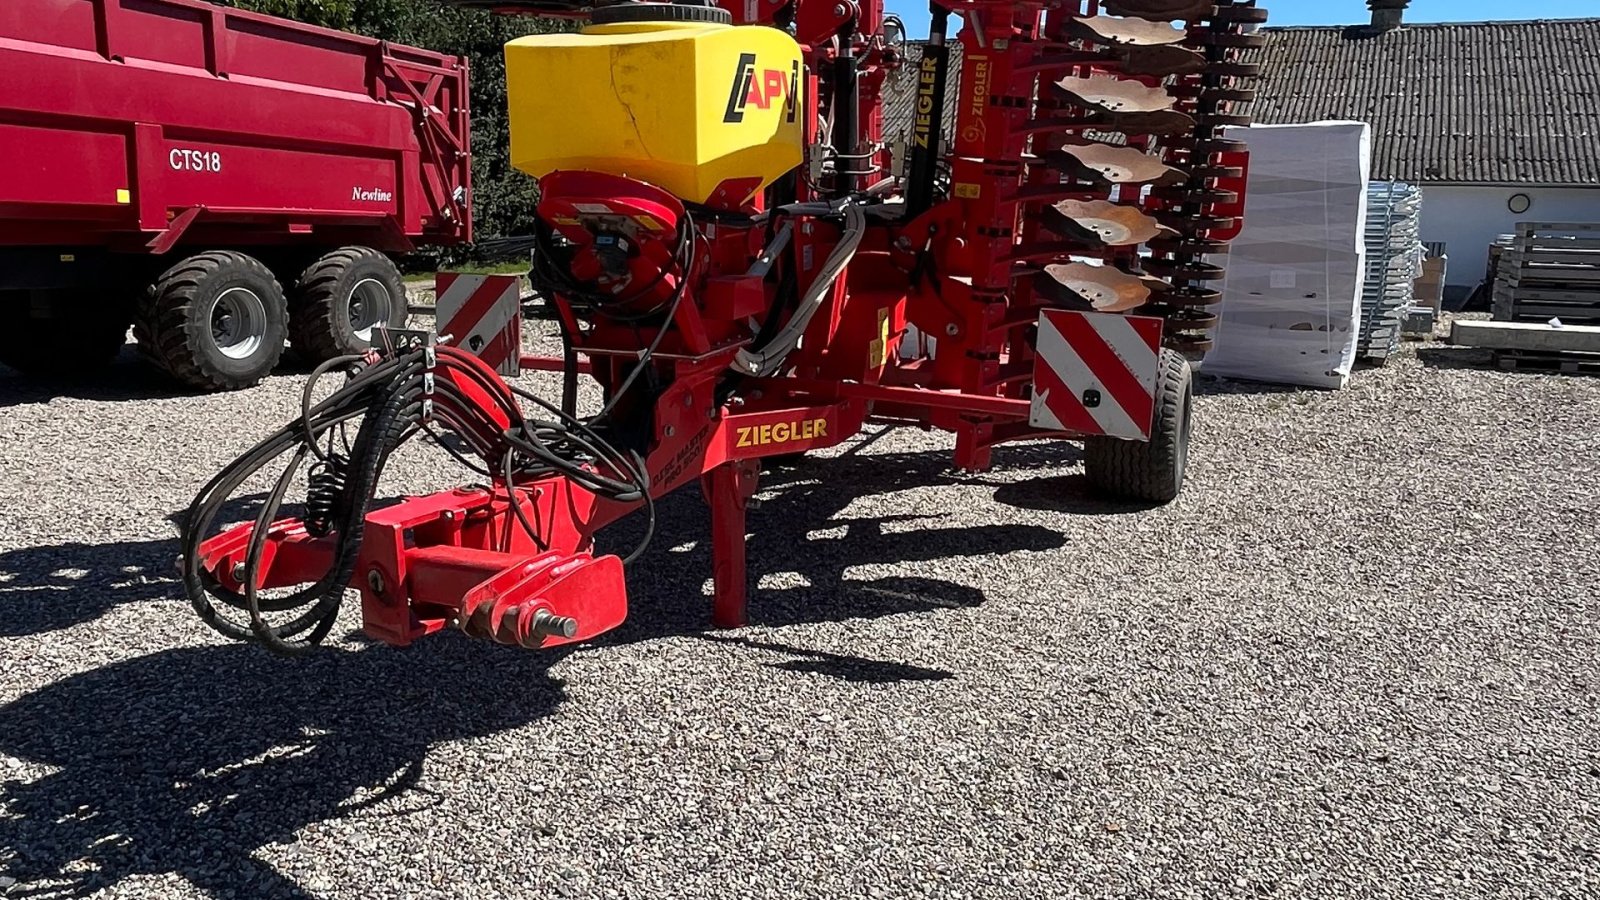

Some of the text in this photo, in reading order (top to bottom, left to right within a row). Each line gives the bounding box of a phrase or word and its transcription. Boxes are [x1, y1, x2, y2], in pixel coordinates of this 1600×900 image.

[914, 56, 938, 150] ZIEGLER
[971, 62, 988, 116] ZIEGLER
[169, 149, 221, 172] CTS18
[352, 186, 392, 202] Newline
[736, 418, 827, 448] ZIEGLER
